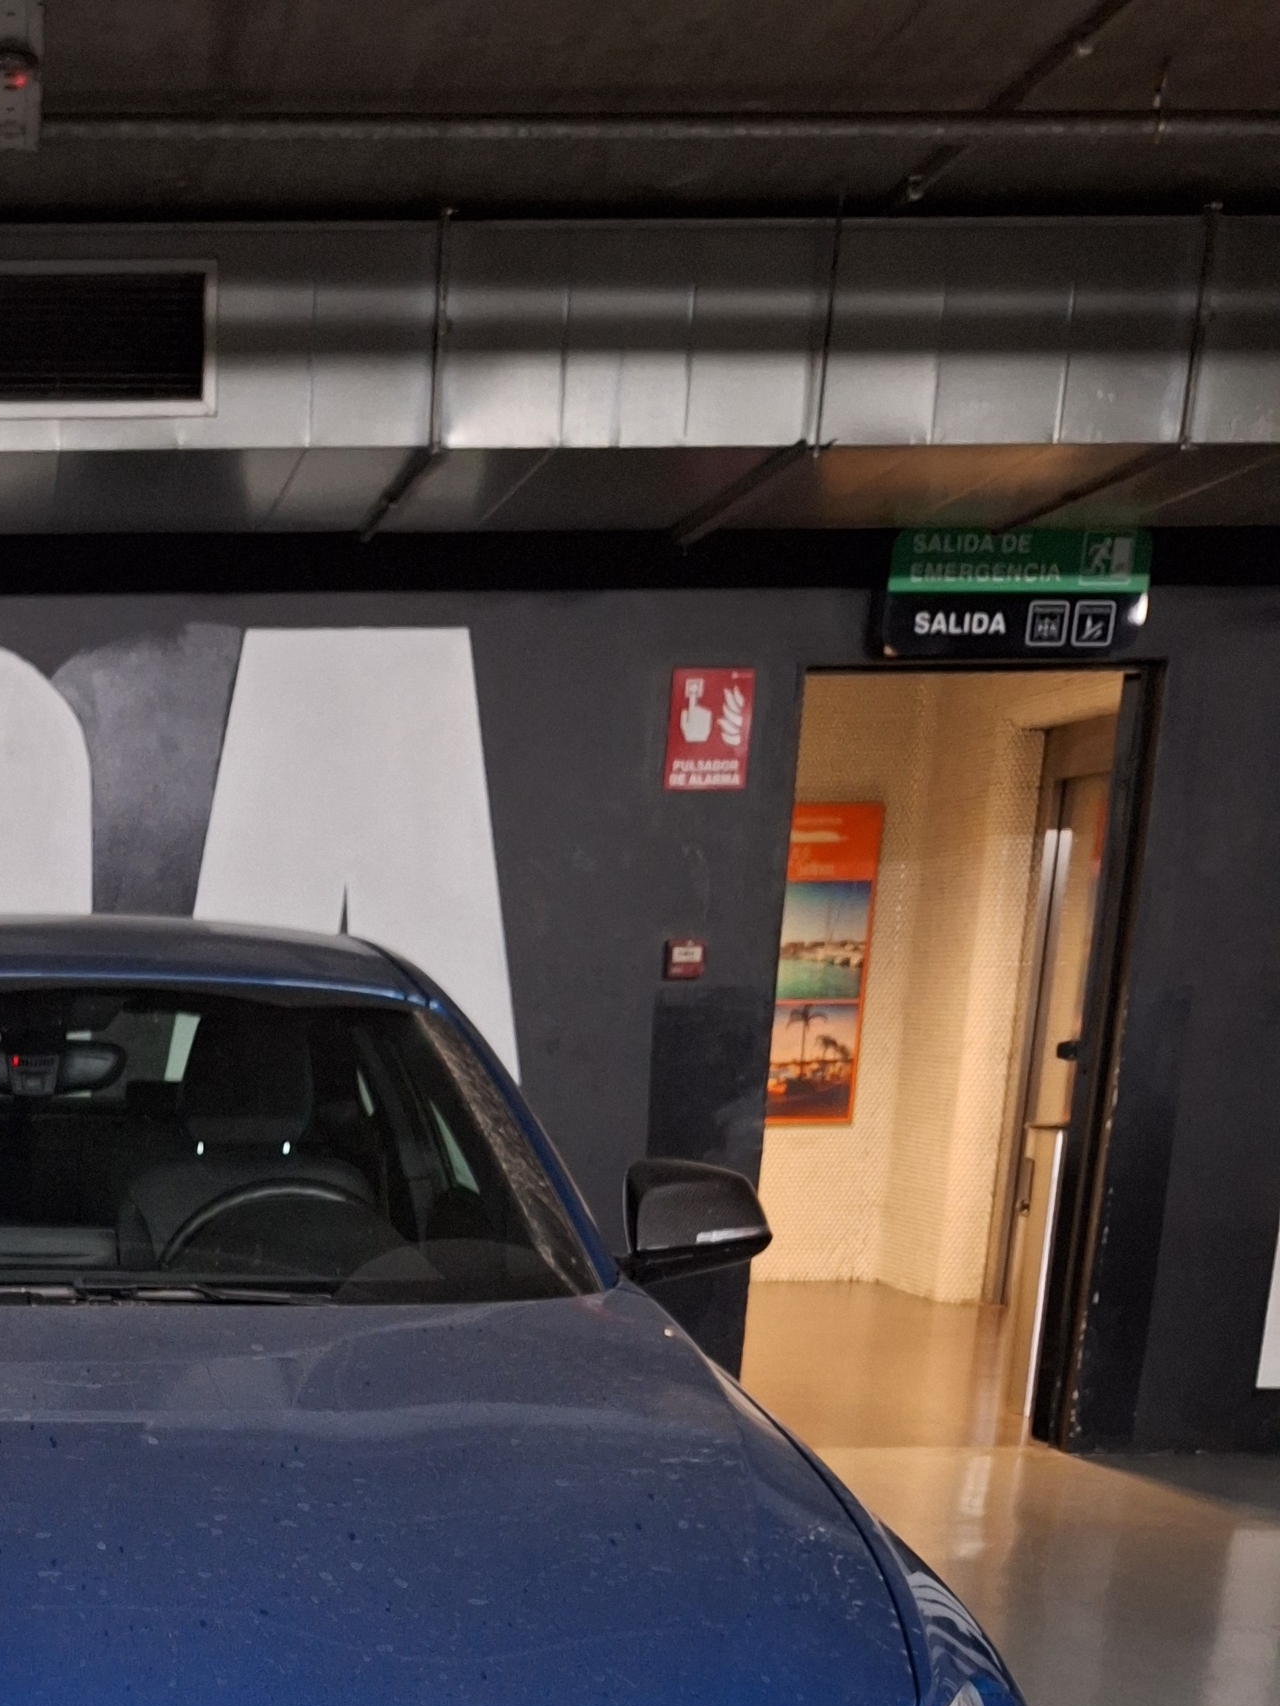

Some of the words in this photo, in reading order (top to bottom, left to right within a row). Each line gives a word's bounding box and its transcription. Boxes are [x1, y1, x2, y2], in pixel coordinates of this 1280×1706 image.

[913, 533, 994, 554] SALIDA
[1001, 534, 1032, 554] DE
[910, 563, 1060, 582] EMERGENCIA
[914, 612, 1006, 635] SALIDA
[672, 759, 739, 772] PULSADOR
[669, 773, 686, 785] DE
[688, 773, 740, 785] ALARMA
